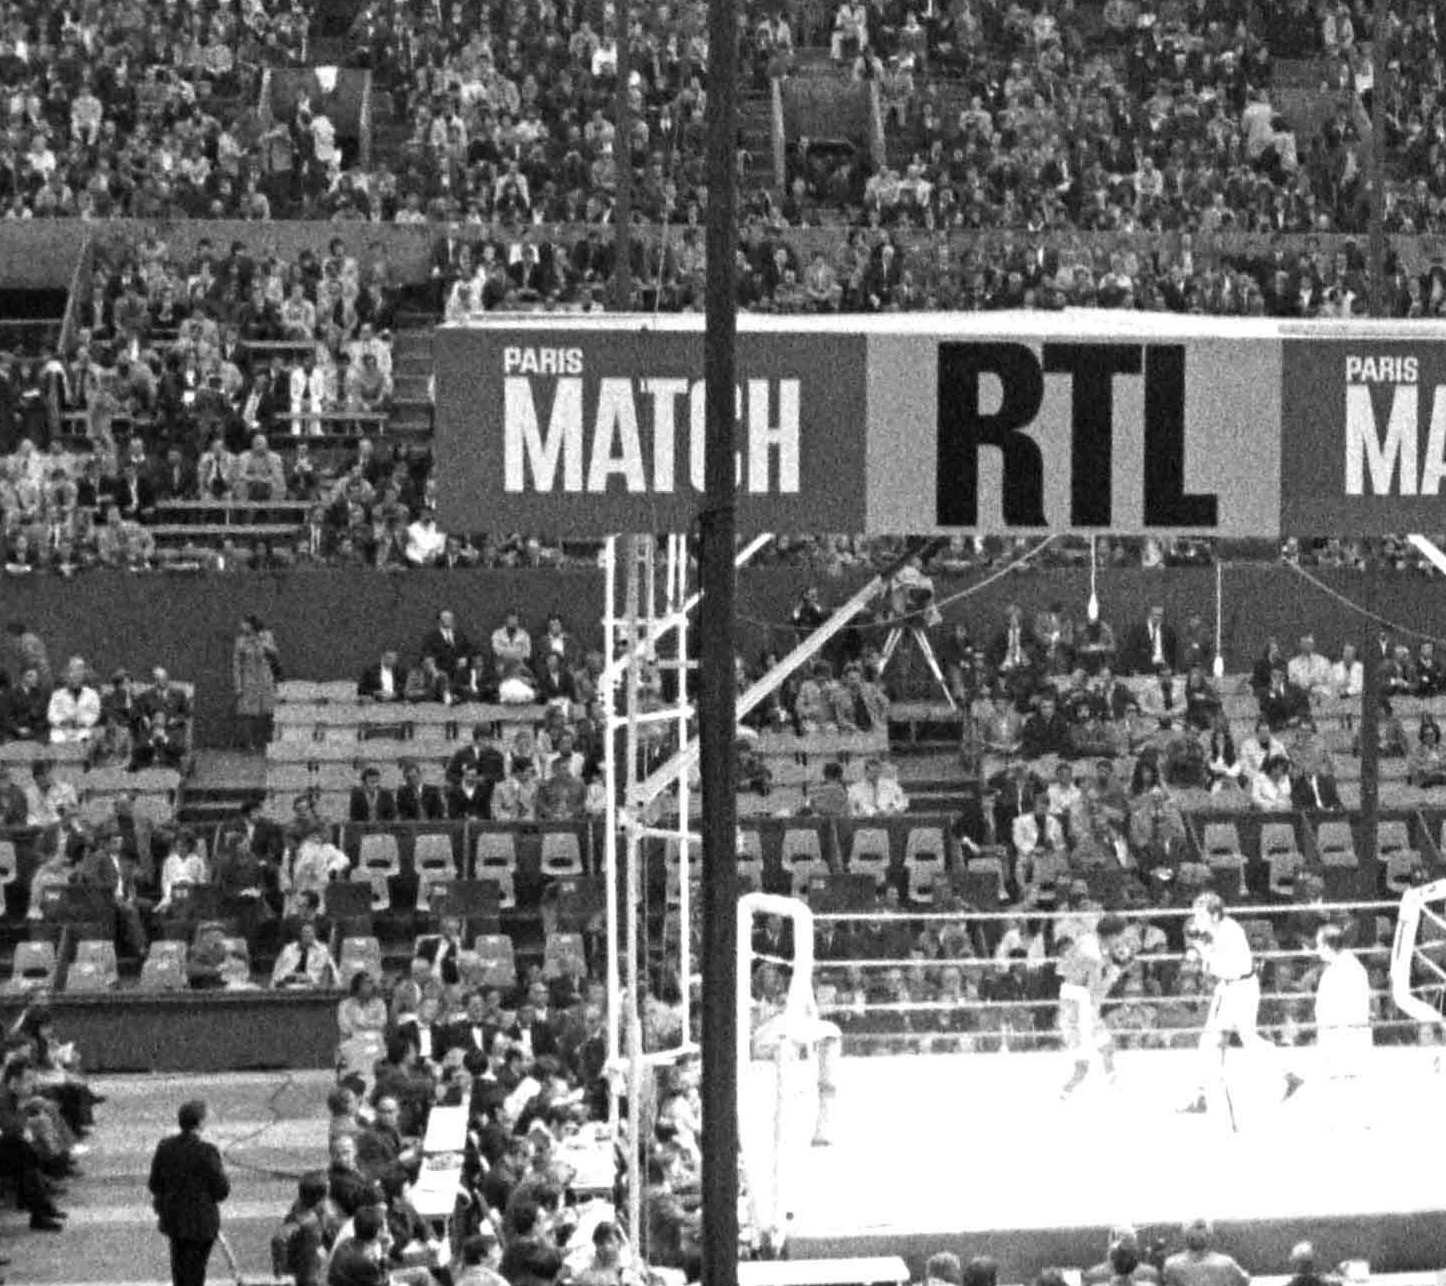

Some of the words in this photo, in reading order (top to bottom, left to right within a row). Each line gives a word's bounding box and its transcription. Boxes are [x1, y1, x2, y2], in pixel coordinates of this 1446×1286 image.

[503, 347, 583, 373] PARIS
[1346, 356, 1418, 382] PARIS
[937, 342, 1218, 527] RTL
